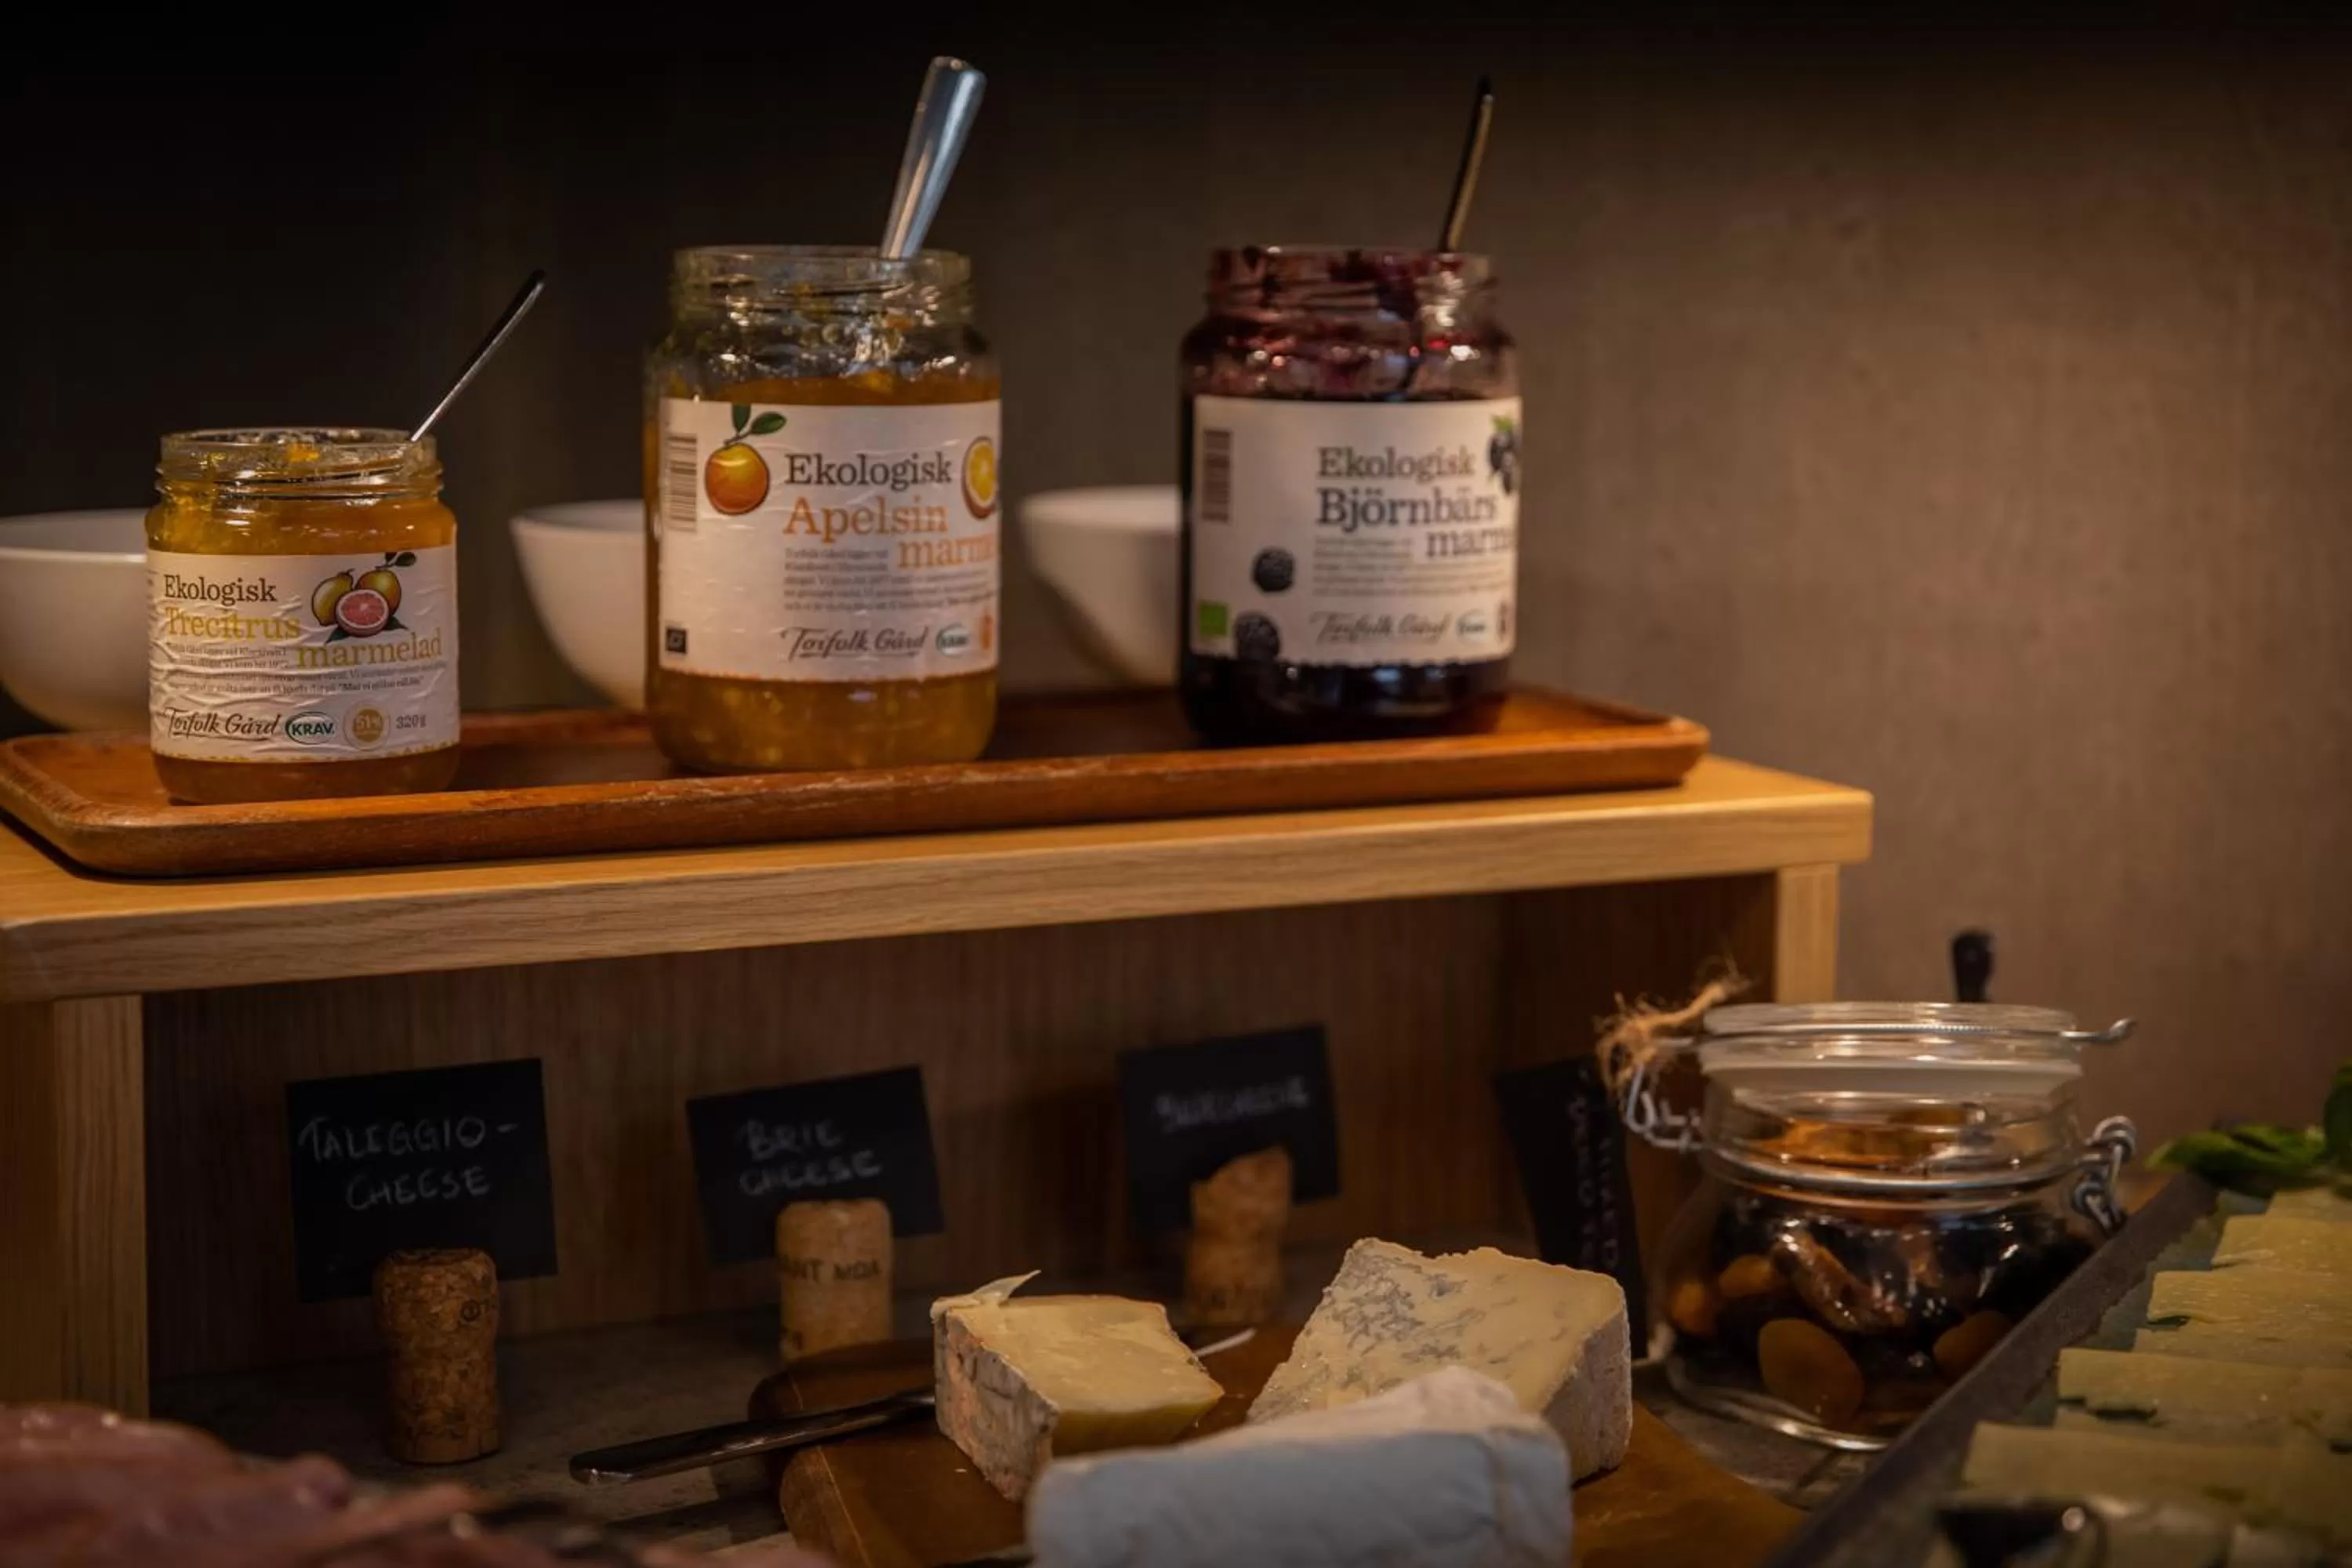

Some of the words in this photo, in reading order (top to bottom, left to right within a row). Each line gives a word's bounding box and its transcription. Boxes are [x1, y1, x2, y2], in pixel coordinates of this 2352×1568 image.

[785, 451, 953, 491] Ekologisk
[1316, 445, 1475, 484] Ekologisk
[782, 495, 949, 544] Apelsin
[1316, 486, 1497, 532] Björnbärs
[164, 575, 277, 605] Ekologisk
[165, 607, 301, 642] Trecitrus
[780, 627, 868, 660] Torfolk
[874, 626, 928, 656] Gård
[296, 628, 442, 669] marmelad
[165, 706, 221, 739] Torfolk
[225, 712, 282, 736] Gård
[347, 1166, 490, 1211] CHEESE
